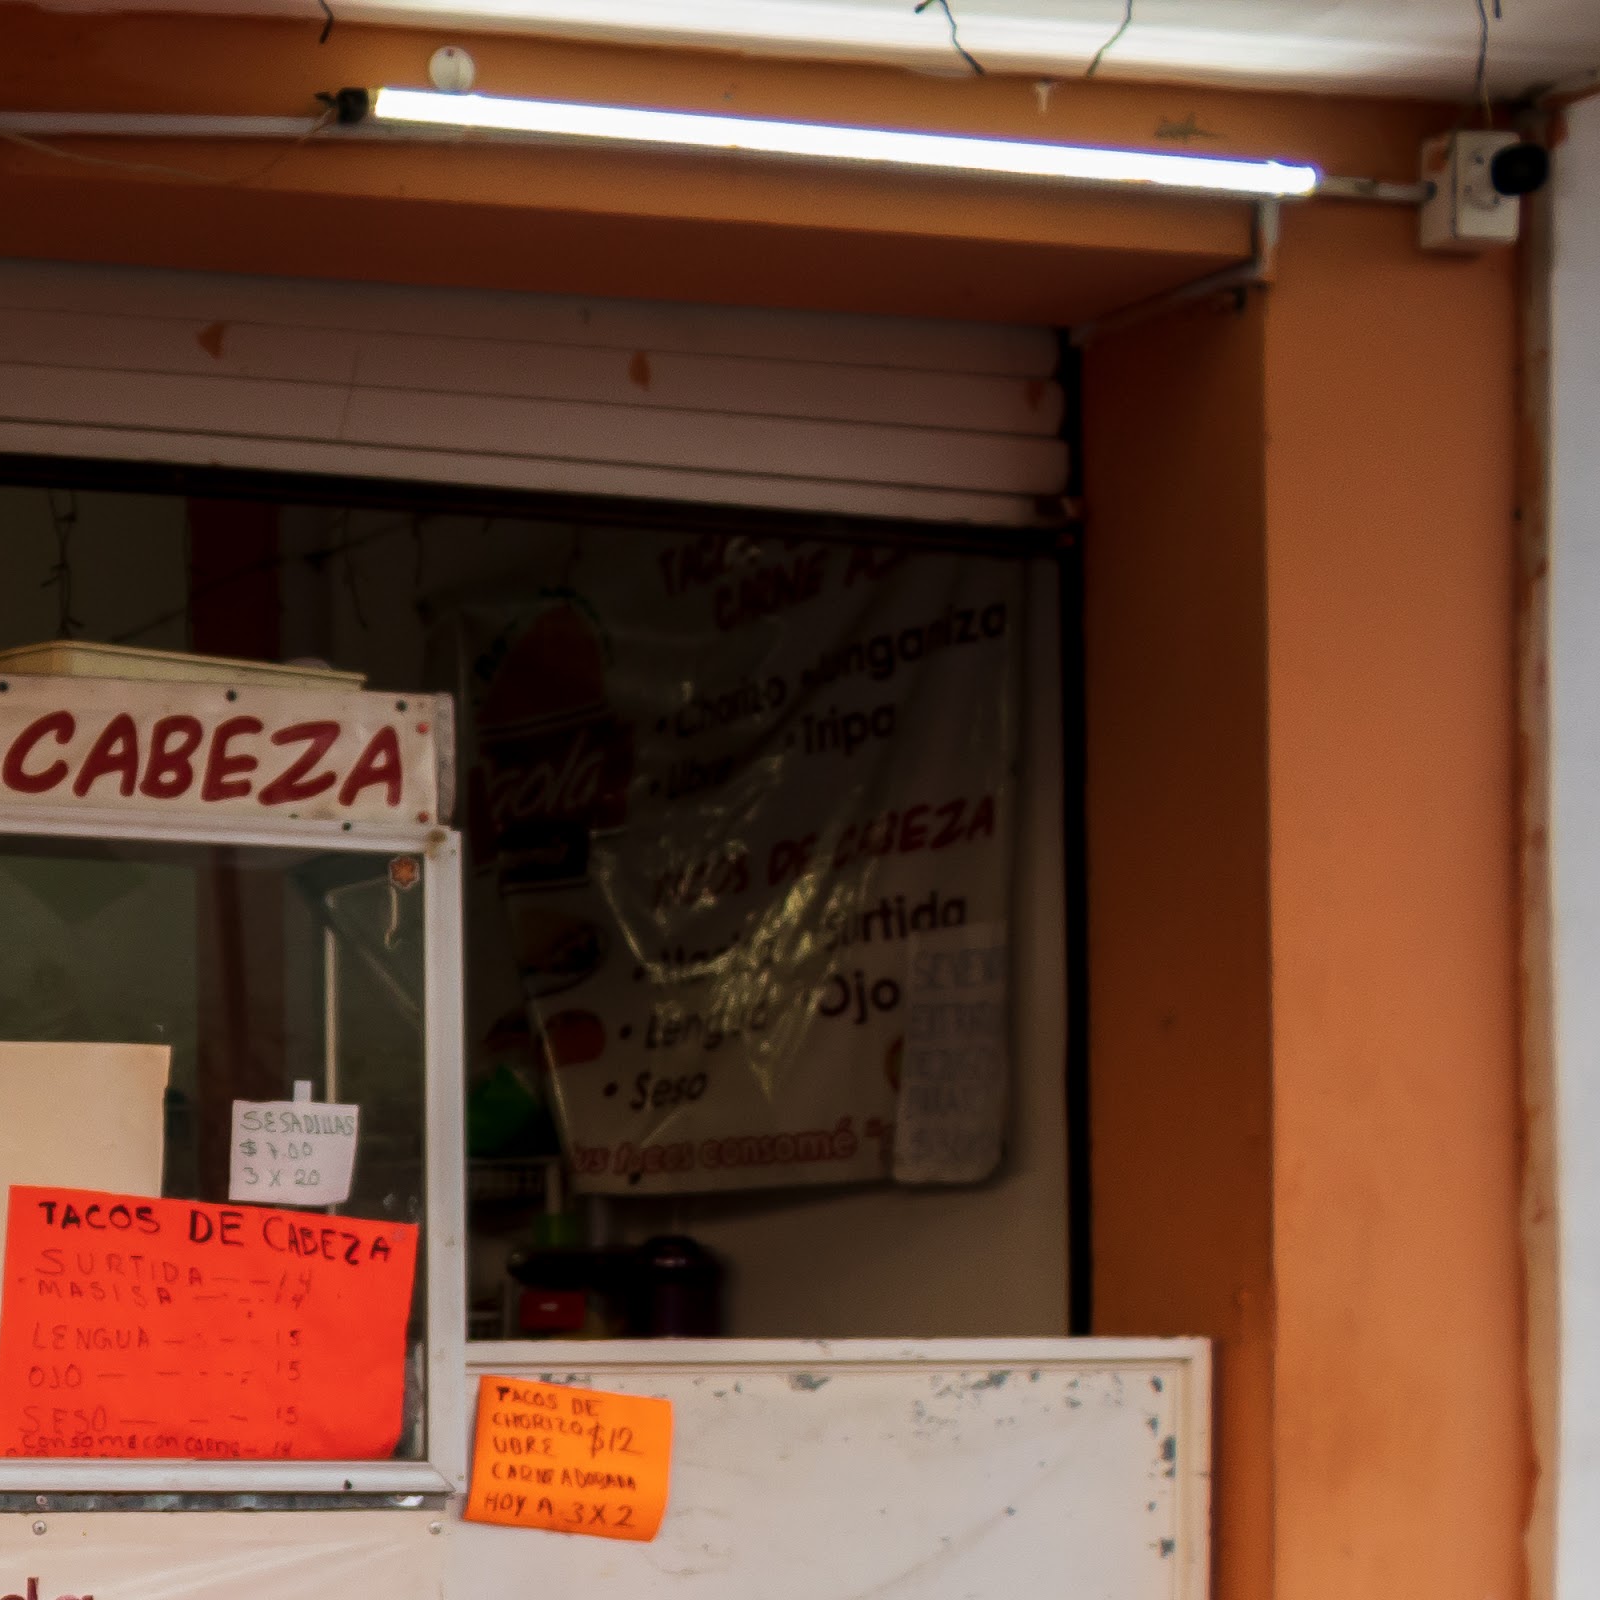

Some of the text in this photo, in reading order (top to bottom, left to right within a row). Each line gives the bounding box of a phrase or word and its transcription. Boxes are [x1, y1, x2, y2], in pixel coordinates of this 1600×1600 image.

[0, 710, 402, 807] CABEZA
[38, 1200, 392, 1266] TACOS DE CABEZA
[34, 1248, 203, 1288] SURTIDA
[31, 1321, 150, 1351] LENGUA
[496, 1385, 606, 1417] TACOS DE
[18, 1405, 108, 1436] SESO
[587, 1420, 645, 1459] $12
[484, 1491, 528, 1517] HOY
